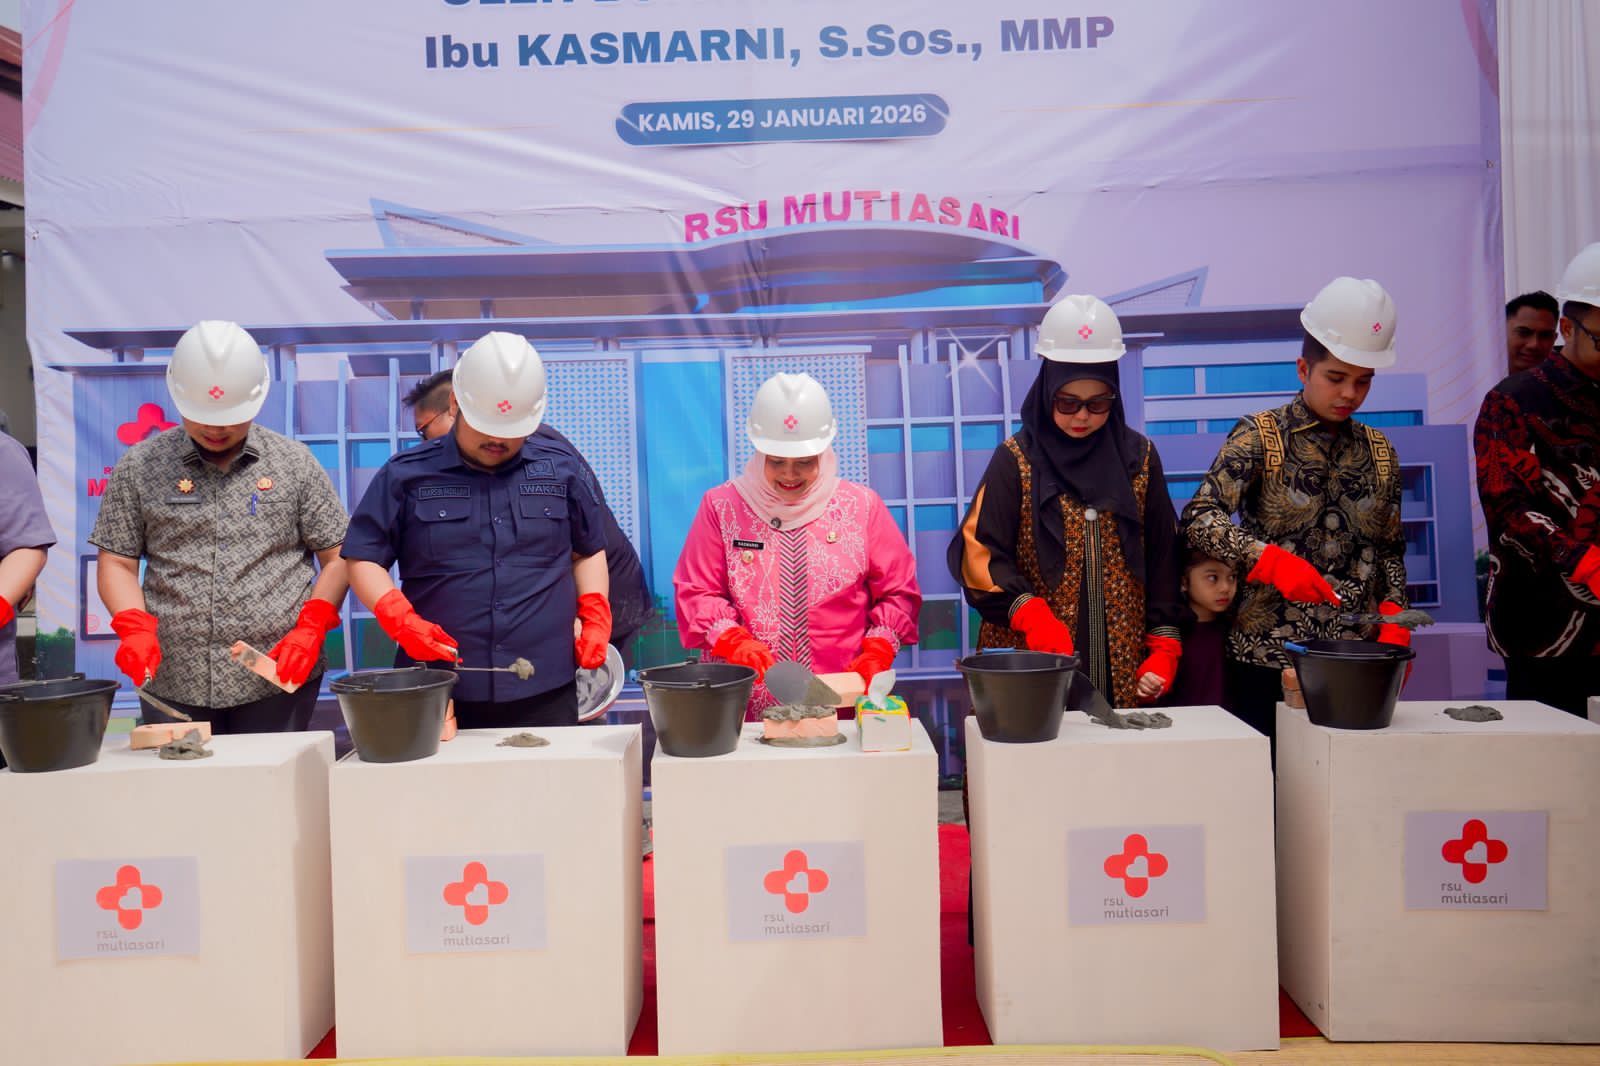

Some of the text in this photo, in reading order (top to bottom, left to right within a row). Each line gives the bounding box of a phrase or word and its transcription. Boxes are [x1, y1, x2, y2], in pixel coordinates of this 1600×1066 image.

[425, 16, 1114, 68] Ibu KASMARNI, S.Sos., MMP
[638, 104, 927, 133] KAMIS, 29 JANUARI 2026
[684, 190, 1020, 243] RSU MUTIASARI
[1440, 883, 1462, 891] rsu
[1103, 897, 1124, 906] rsu
[1441, 893, 1508, 904] mutiasari
[764, 913, 785, 922] rsu
[1103, 906, 1169, 918] mutiasari
[443, 924, 464, 934] rsu
[764, 921, 831, 934] mutiasari
[96, 939, 165, 952] mutiasari
[443, 933, 511, 946] mutiasari
